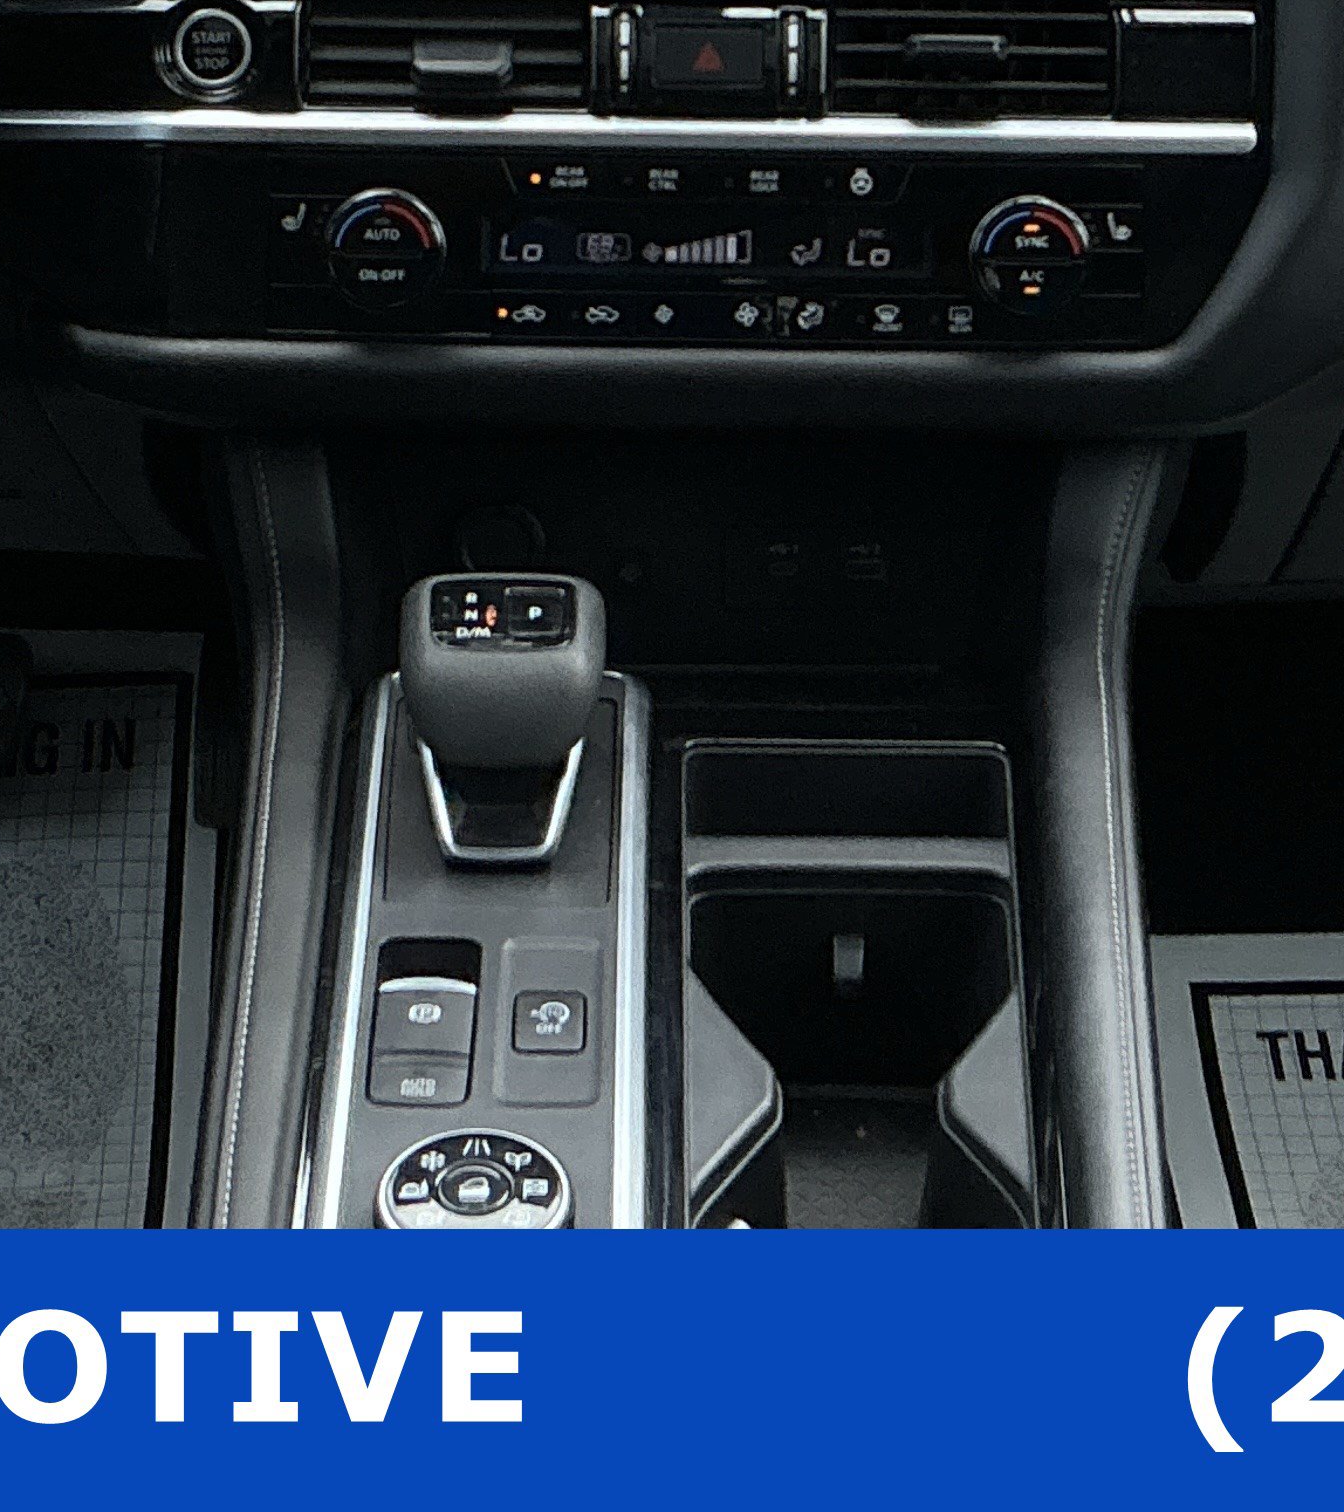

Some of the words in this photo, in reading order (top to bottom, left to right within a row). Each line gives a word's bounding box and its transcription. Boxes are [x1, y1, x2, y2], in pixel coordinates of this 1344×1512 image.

[191, 30, 232, 45] START
[194, 55, 231, 70] STOP
[362, 227, 401, 242] AUTO
[1014, 235, 1051, 250] SYNC
[1018, 268, 1046, 284] A/C
[464, 608, 479, 622] N
[528, 605, 543, 620] P
[455, 626, 492, 639] D/M
[80, 719, 136, 775] IN
